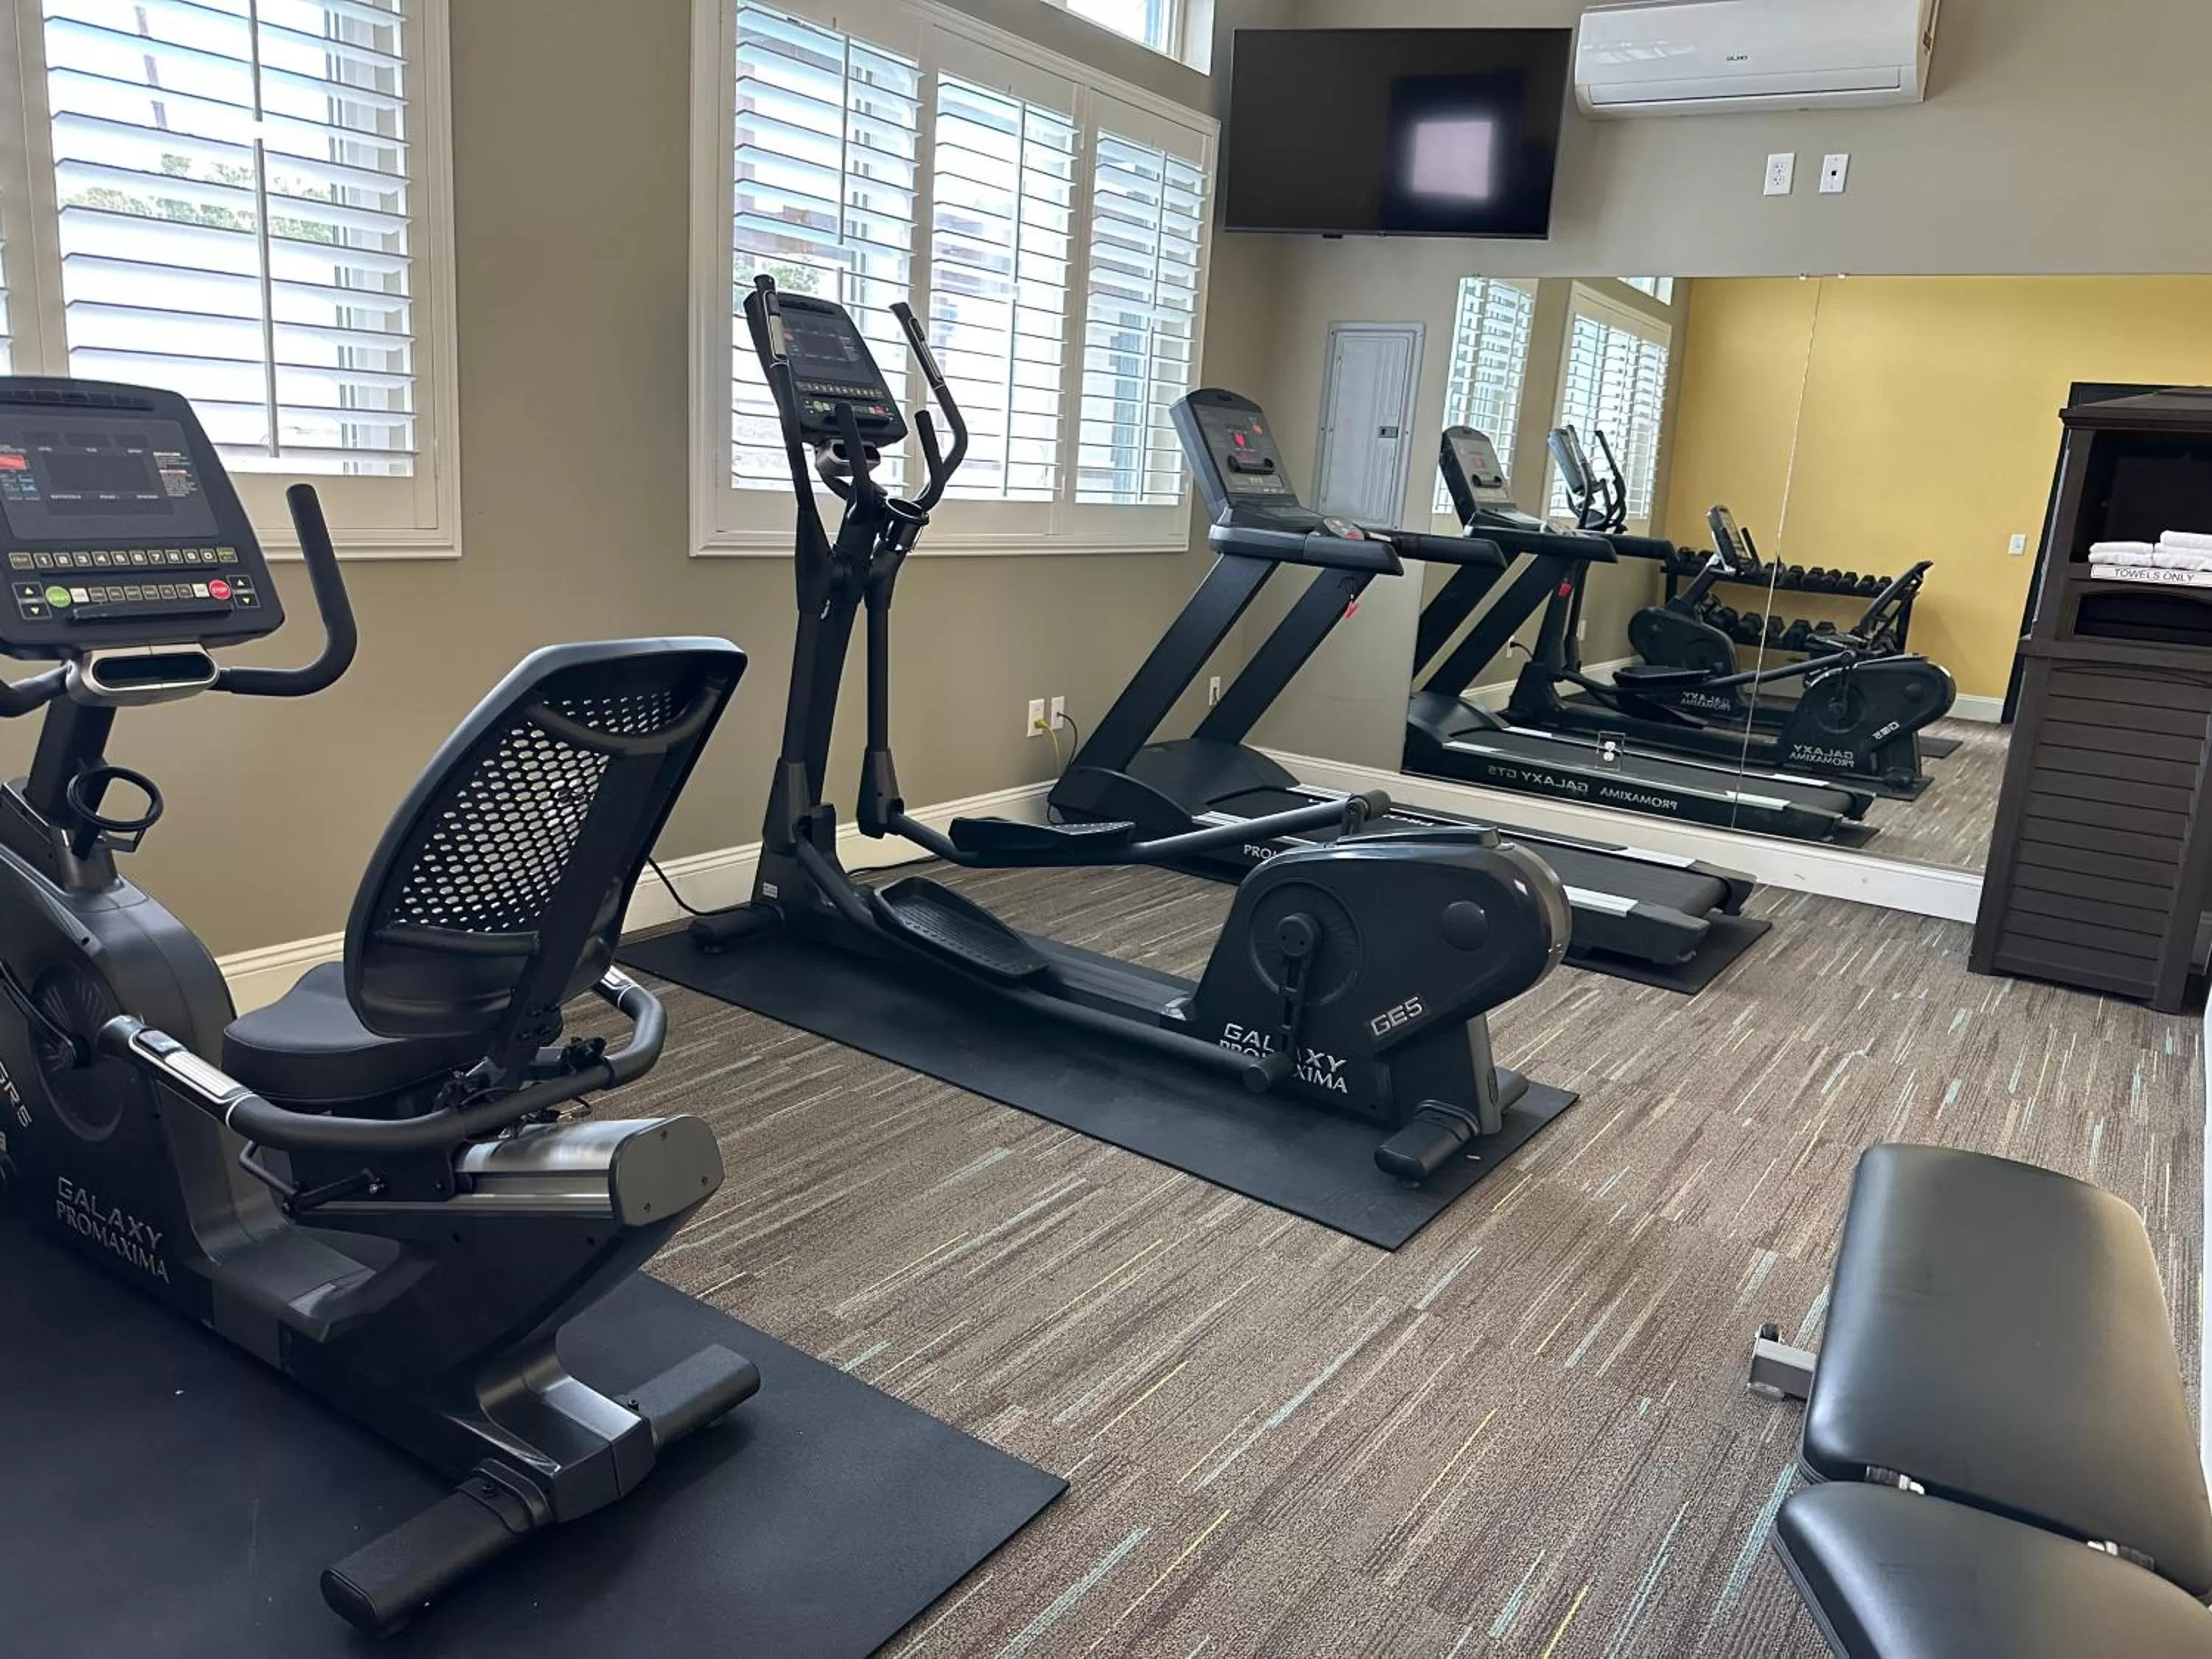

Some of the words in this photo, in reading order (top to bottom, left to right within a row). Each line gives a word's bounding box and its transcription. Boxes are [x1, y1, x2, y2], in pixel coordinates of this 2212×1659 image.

[2115, 568, 2160, 580] TOWELS
[2163, 571, 2194, 581] ONLY
[1243, 844, 1279, 860] PRO
[1369, 995, 1423, 1037] GE5
[58, 1175, 164, 1250] GALAXY
[55, 1199, 171, 1285] PROMAXIMA
